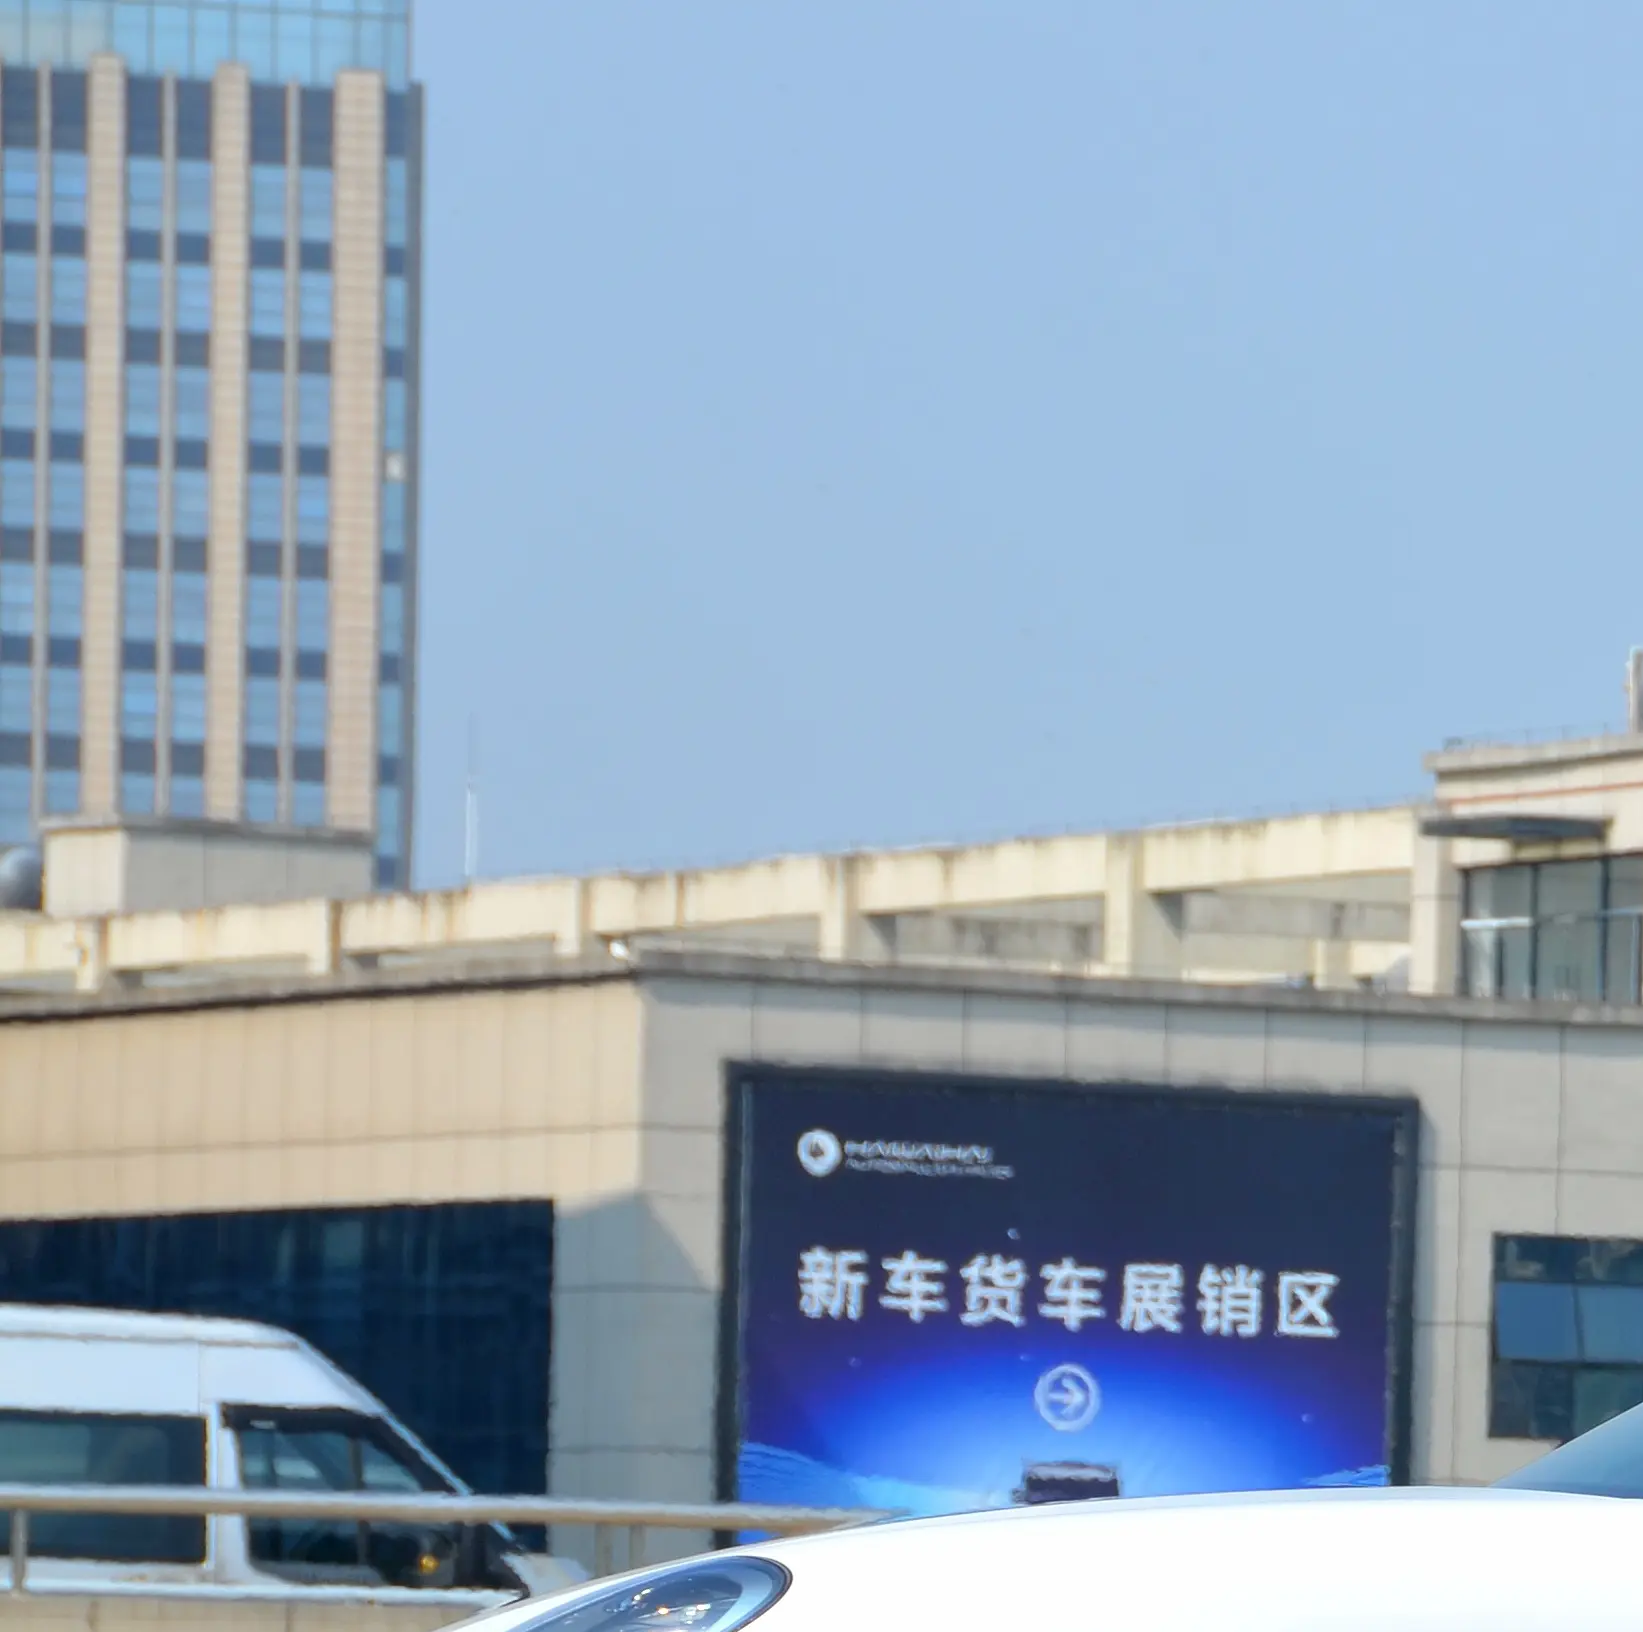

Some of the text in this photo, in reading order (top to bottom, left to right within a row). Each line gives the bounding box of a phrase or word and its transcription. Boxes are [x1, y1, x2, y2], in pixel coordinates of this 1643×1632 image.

[797, 1245, 1341, 1339] 新车货车展销区
